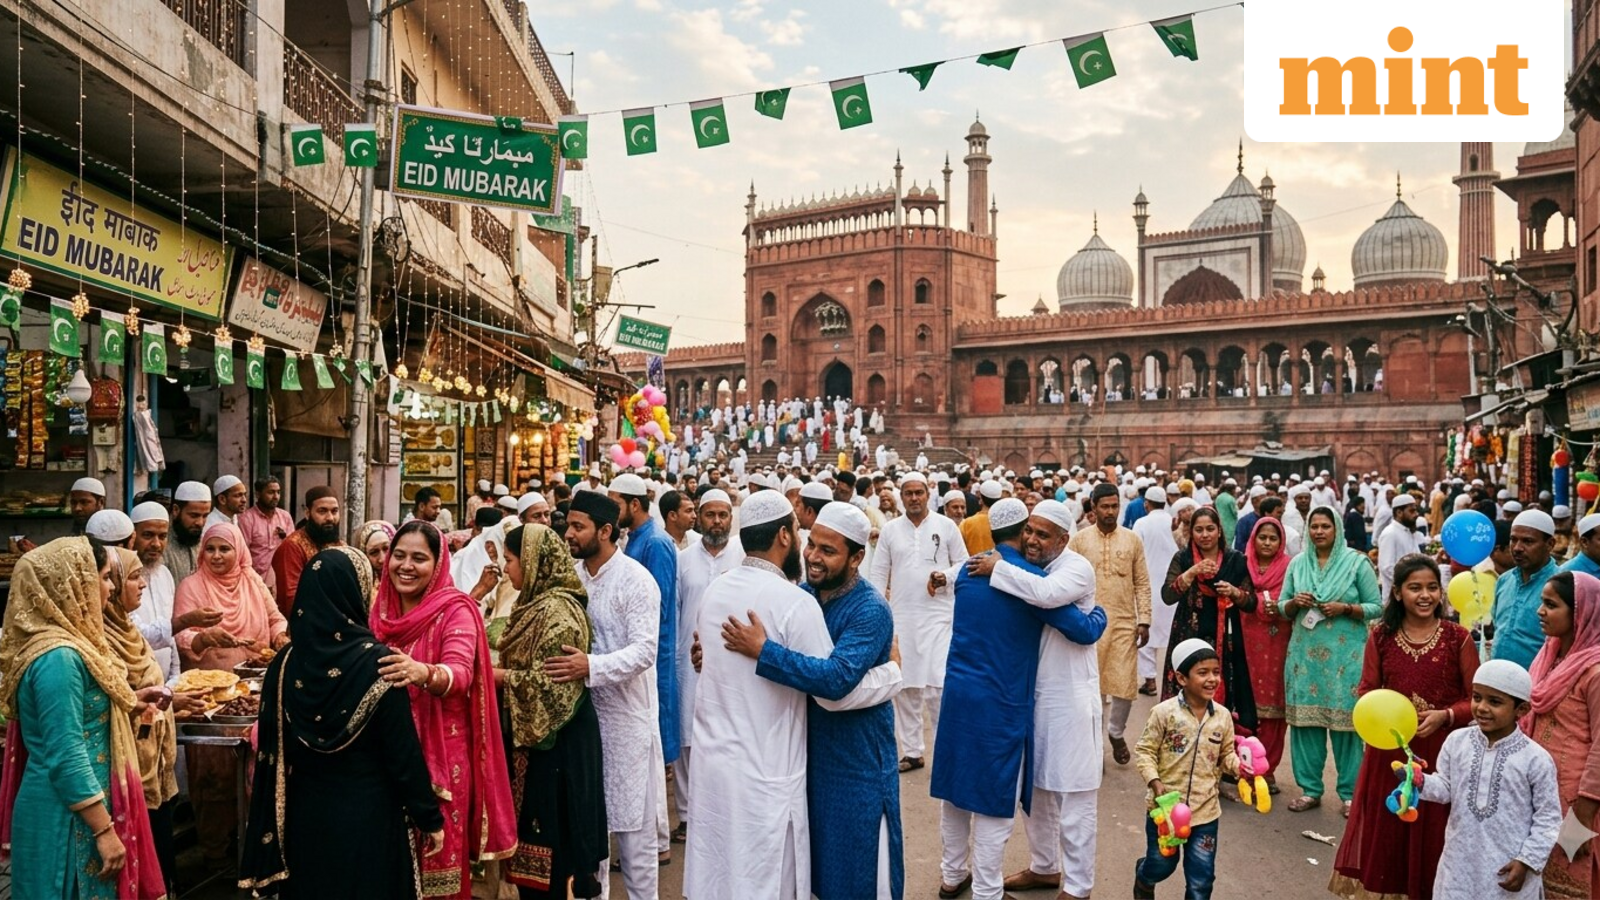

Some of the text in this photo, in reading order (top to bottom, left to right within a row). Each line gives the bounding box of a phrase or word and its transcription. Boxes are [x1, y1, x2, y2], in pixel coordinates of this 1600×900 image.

[404, 161, 548, 202] EID MUBARAK
[19, 217, 60, 258] EID
[65, 234, 164, 292] MUBARAK
